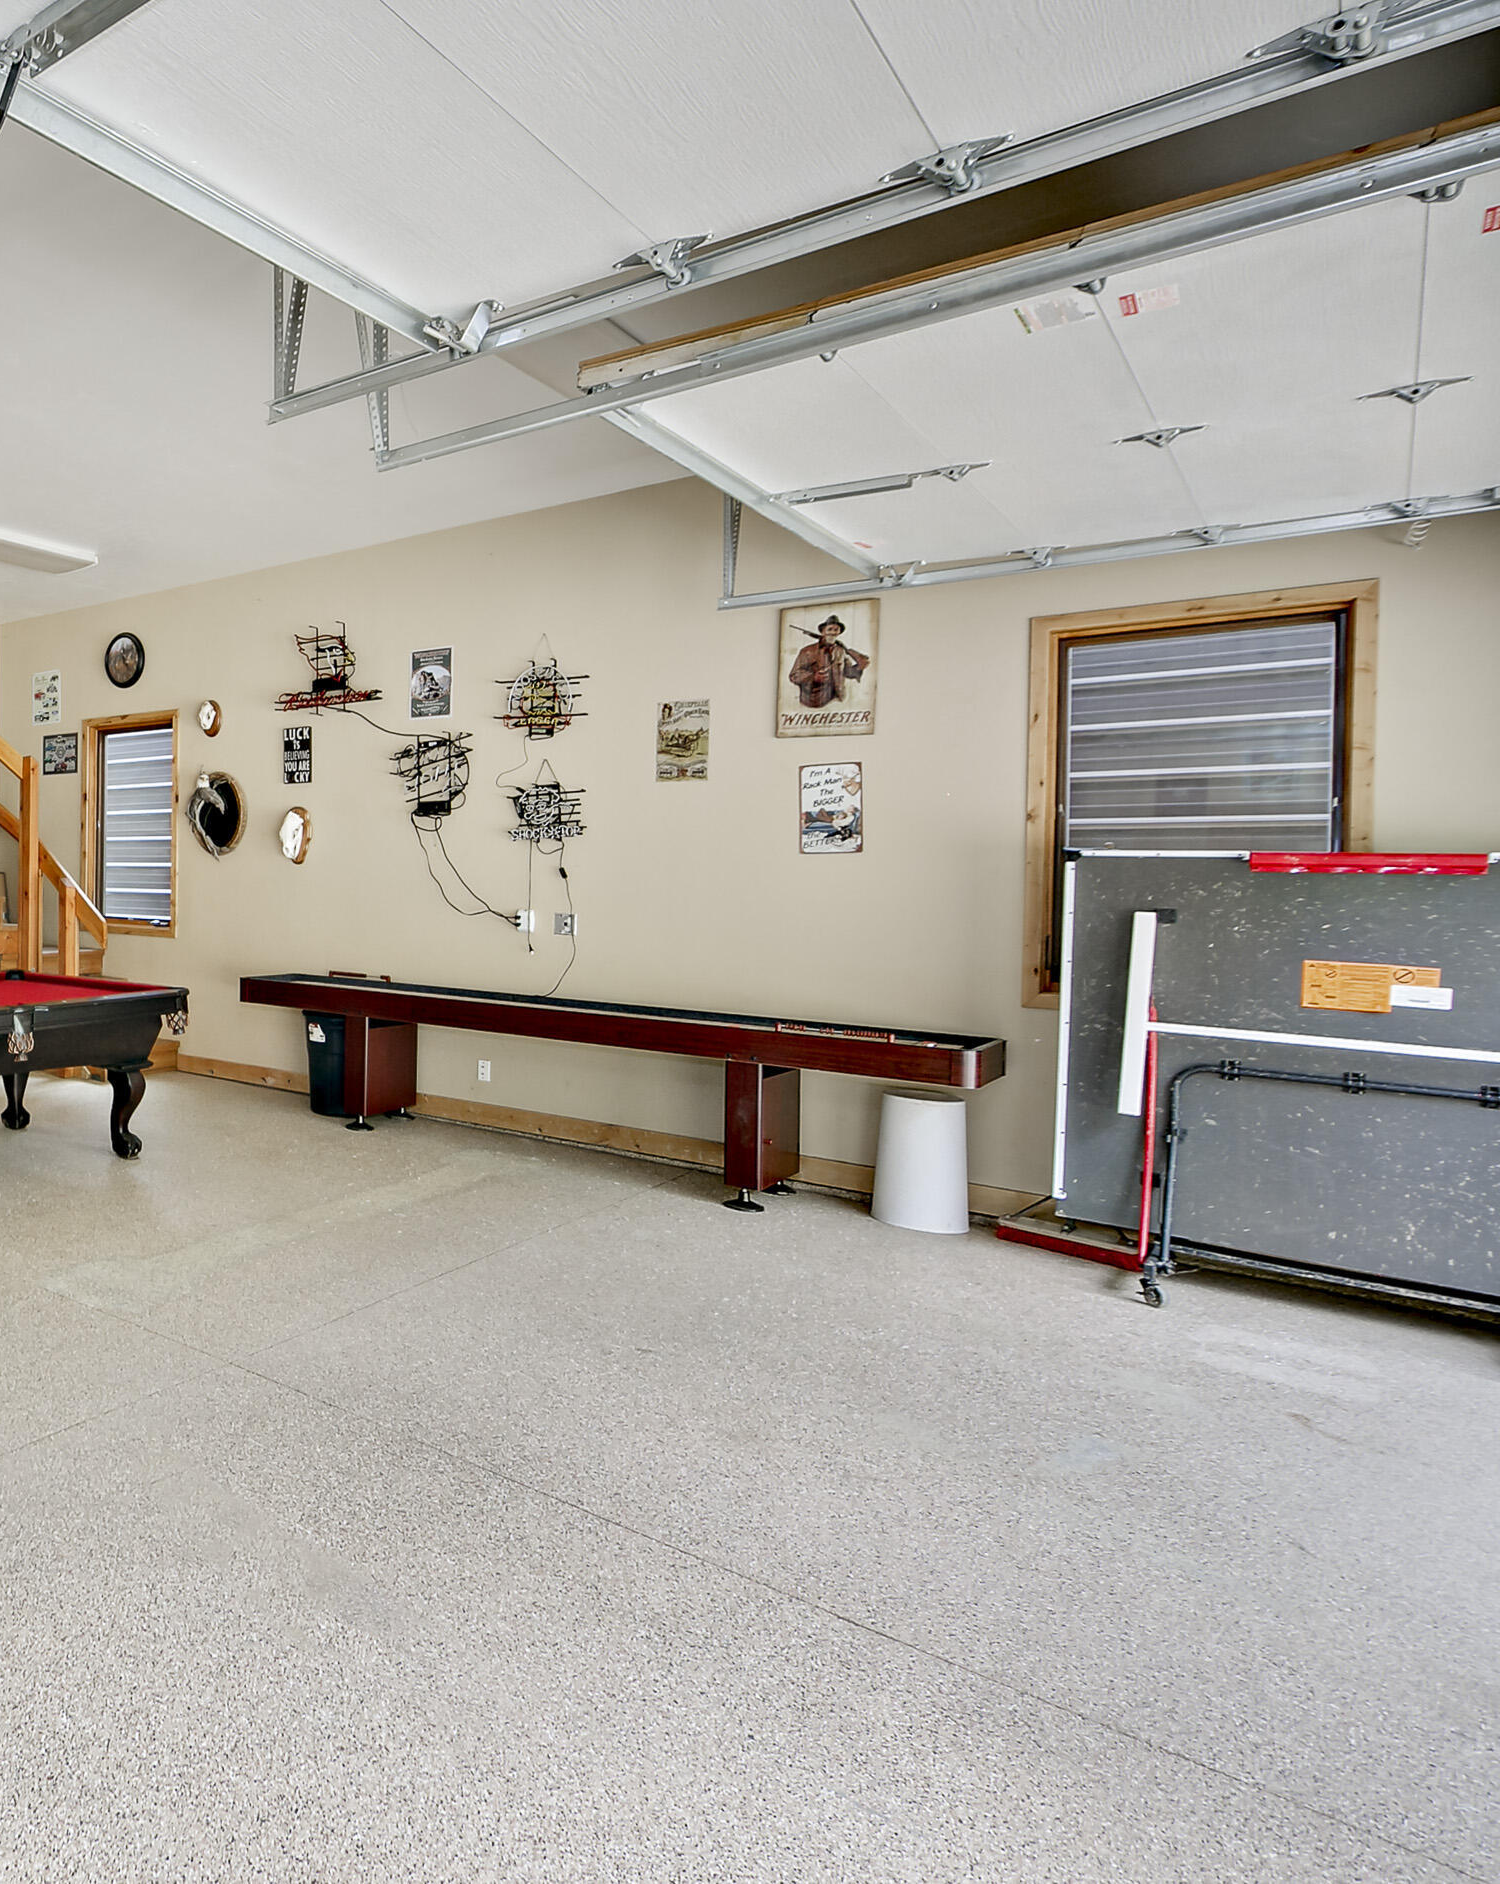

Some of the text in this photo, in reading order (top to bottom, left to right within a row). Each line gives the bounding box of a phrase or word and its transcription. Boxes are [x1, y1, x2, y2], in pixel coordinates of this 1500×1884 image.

[781, 710, 871, 726] WINCHESTER
[284, 727, 310, 741] LUCK
[284, 750, 310, 761] BELIEVING
[284, 760, 310, 772] YOU ARE
[820, 788, 834, 796] The
[813, 795, 844, 807] BIGGER
[511, 827, 548, 841] SHOCK
